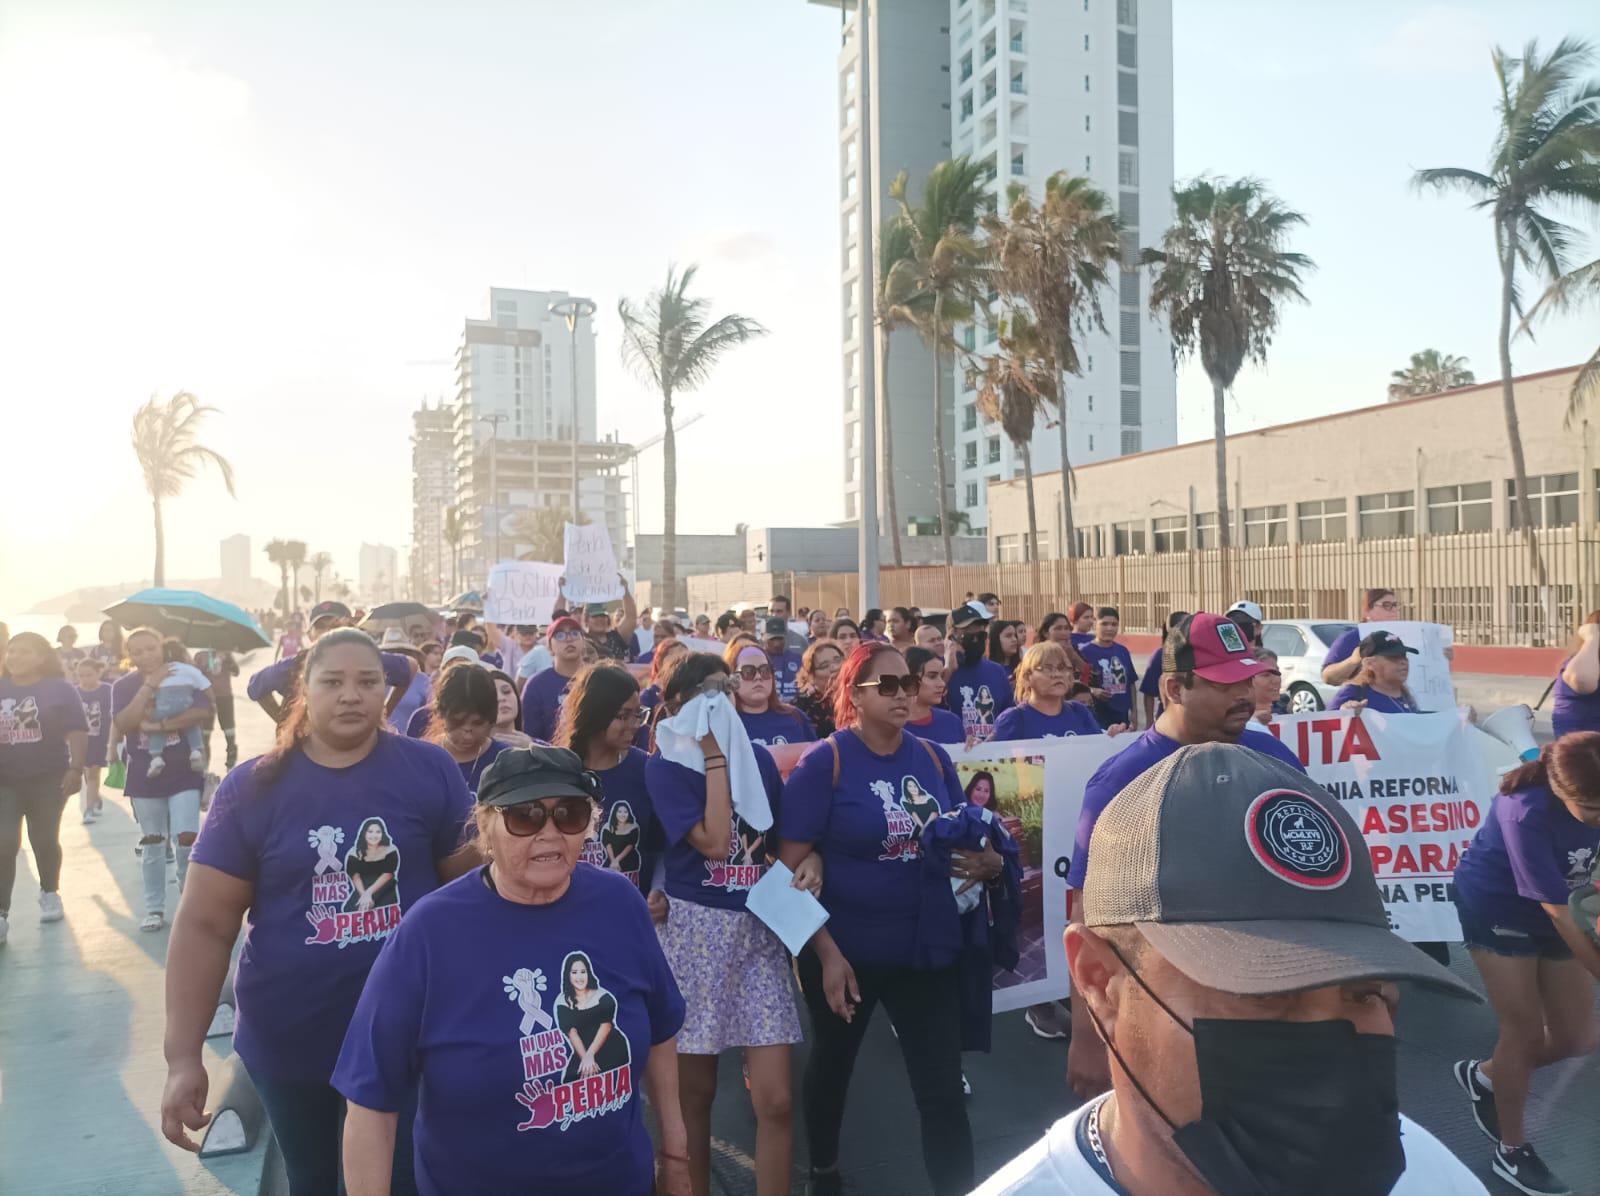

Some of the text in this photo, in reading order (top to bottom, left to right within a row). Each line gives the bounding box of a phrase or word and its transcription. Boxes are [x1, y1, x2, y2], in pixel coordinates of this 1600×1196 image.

[1321, 776, 1364, 800] NIA
[1363, 800, 1480, 835] ASESINO
[336, 905, 401, 940] PERLA
[521, 1029, 563, 1053] NI UNA
[554, 1065, 631, 1120] PERLA
